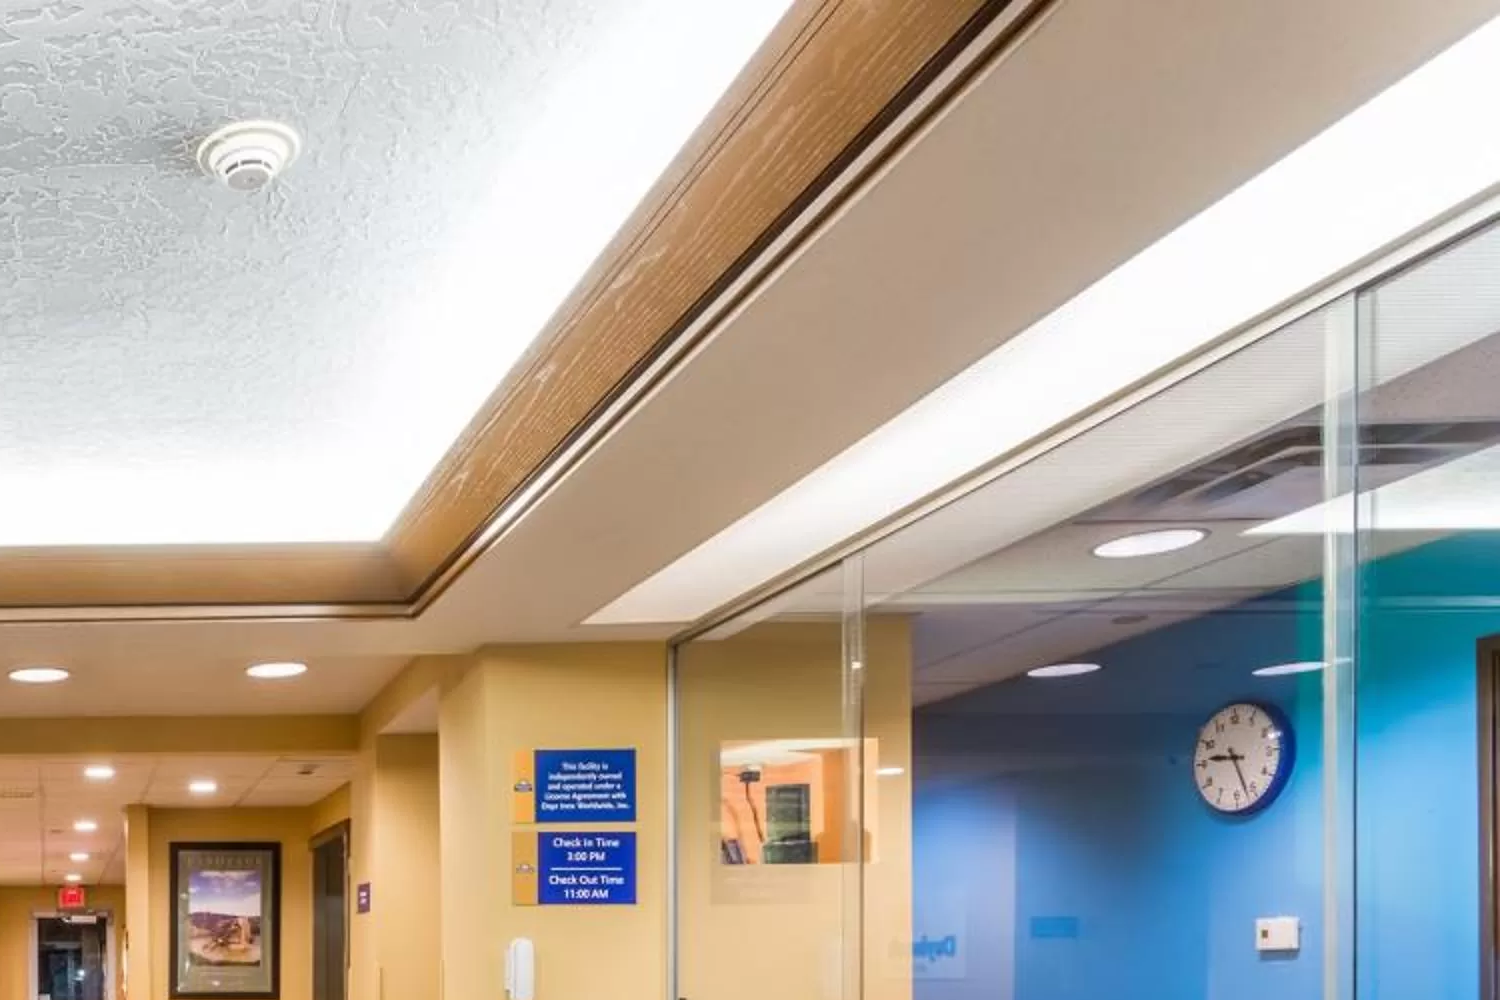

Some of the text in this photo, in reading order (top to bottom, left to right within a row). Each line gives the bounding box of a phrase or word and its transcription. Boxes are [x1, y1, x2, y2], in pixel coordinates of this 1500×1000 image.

[548, 772, 622, 781] independently owned
[547, 782, 561, 790] and
[562, 782, 593, 791] operated
[594, 782, 615, 790] under
[553, 837, 581, 847] Check
[596, 837, 620, 847] Time
[567, 851, 606, 861] 3:00 PM
[549, 874, 625, 885] Check Out Time
[564, 889, 609, 899] 11:00 AM
